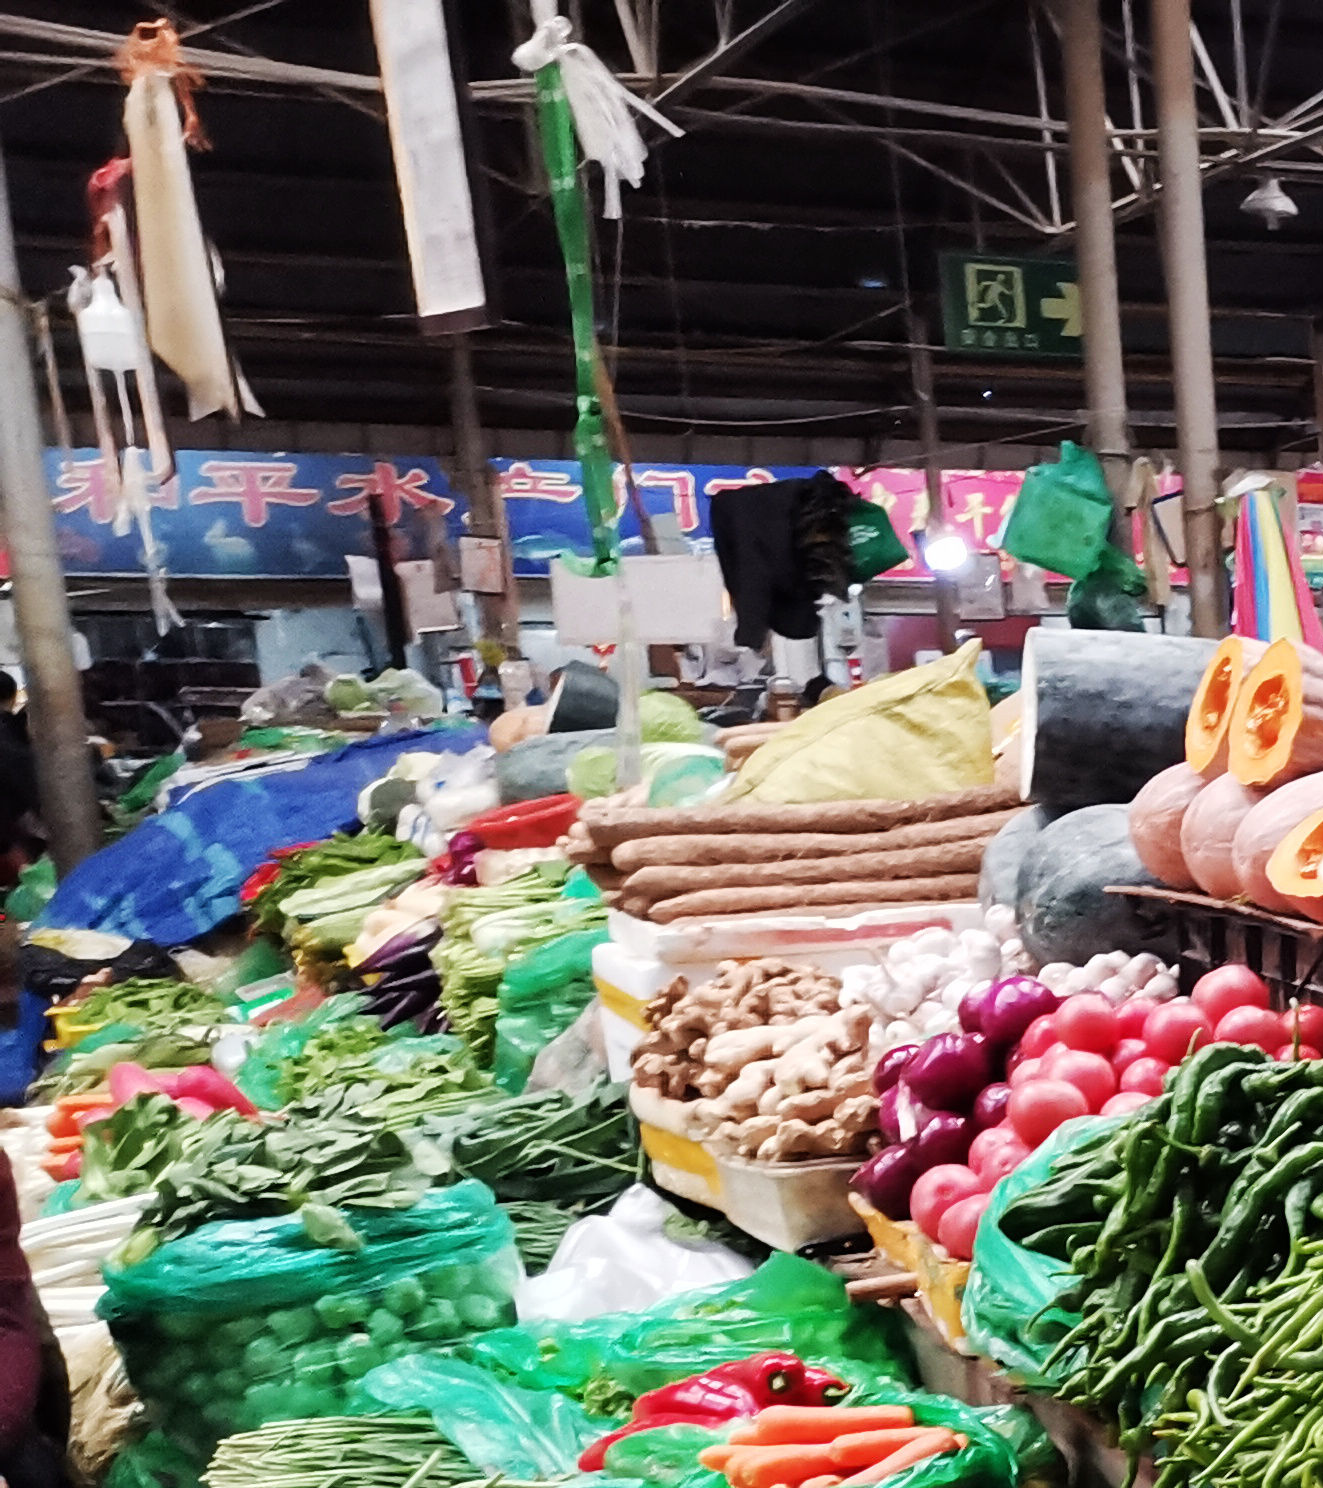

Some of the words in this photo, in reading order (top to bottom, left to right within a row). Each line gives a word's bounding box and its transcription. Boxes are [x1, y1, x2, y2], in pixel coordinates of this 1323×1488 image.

[52, 460, 778, 533] 和平水产门
